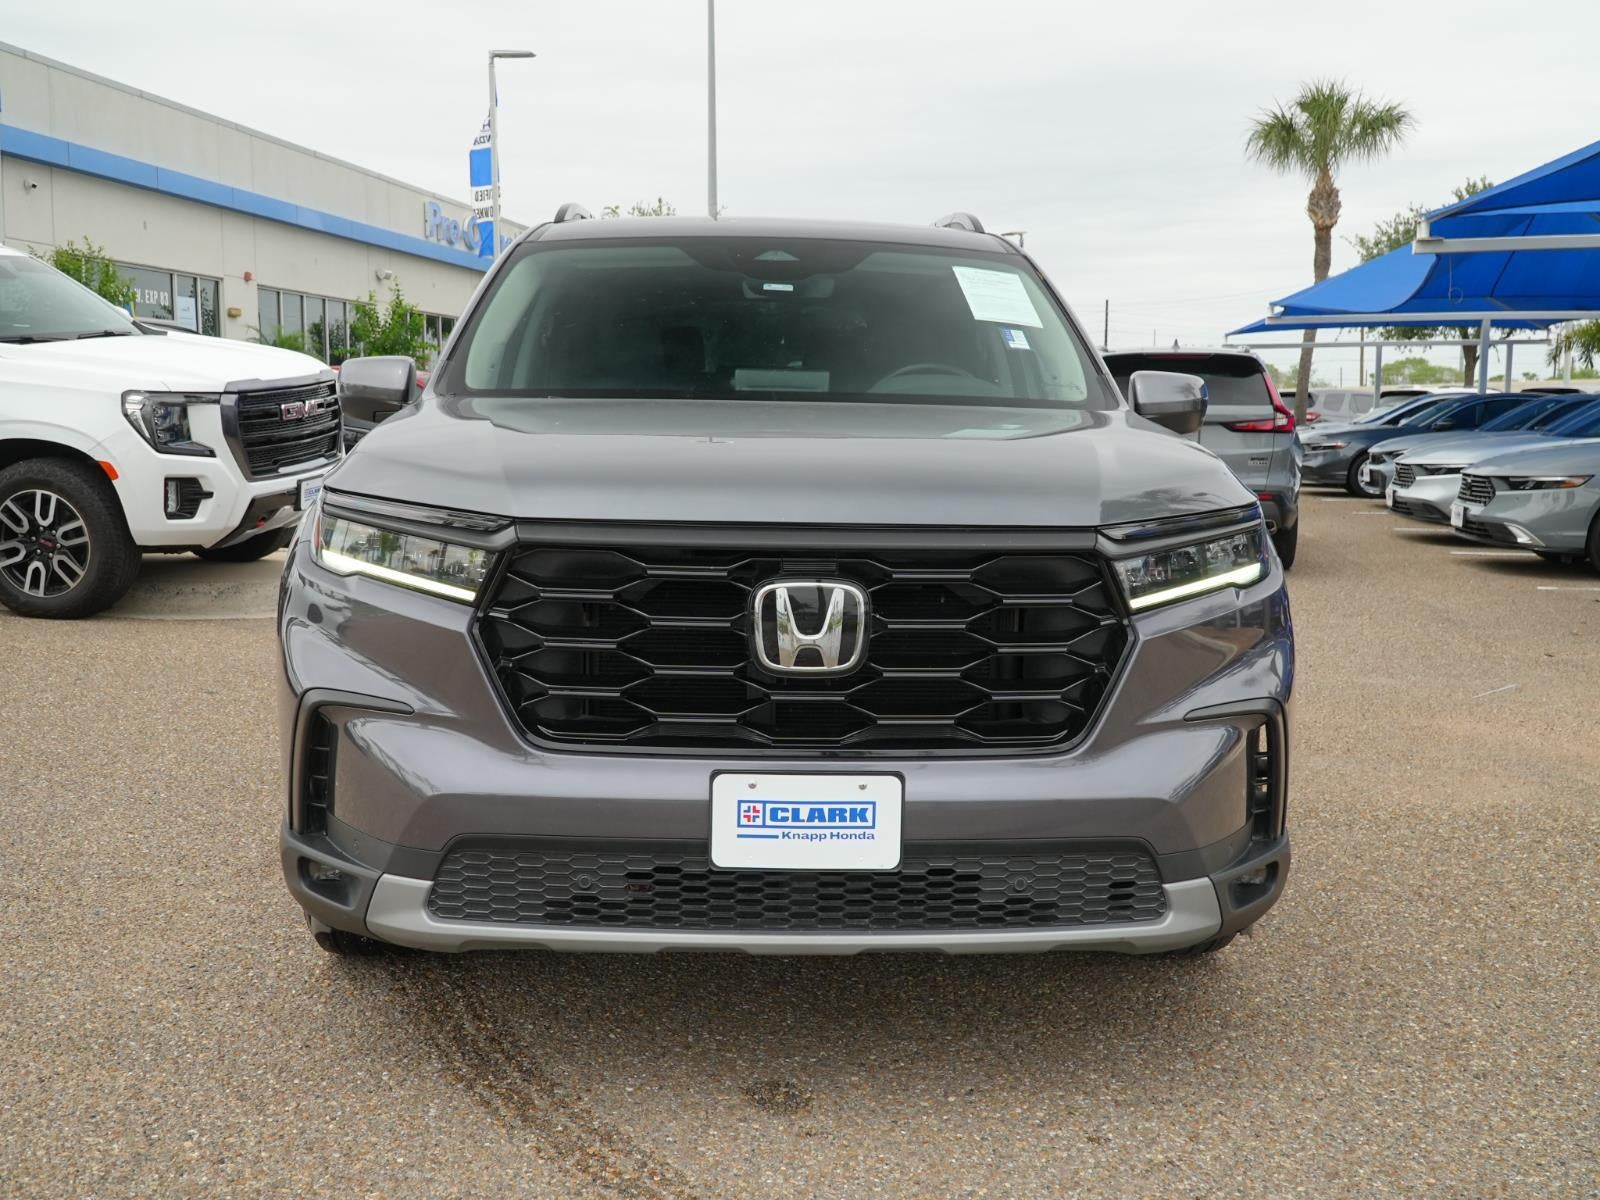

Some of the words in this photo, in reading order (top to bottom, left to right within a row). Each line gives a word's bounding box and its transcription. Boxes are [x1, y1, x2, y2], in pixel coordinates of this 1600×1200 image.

[145, 289, 158, 304] EXP
[281, 399, 326, 421] GMC
[769, 807, 869, 823] CLARK
[781, 831, 827, 842] Knapp
[829, 831, 875, 840] Honda
